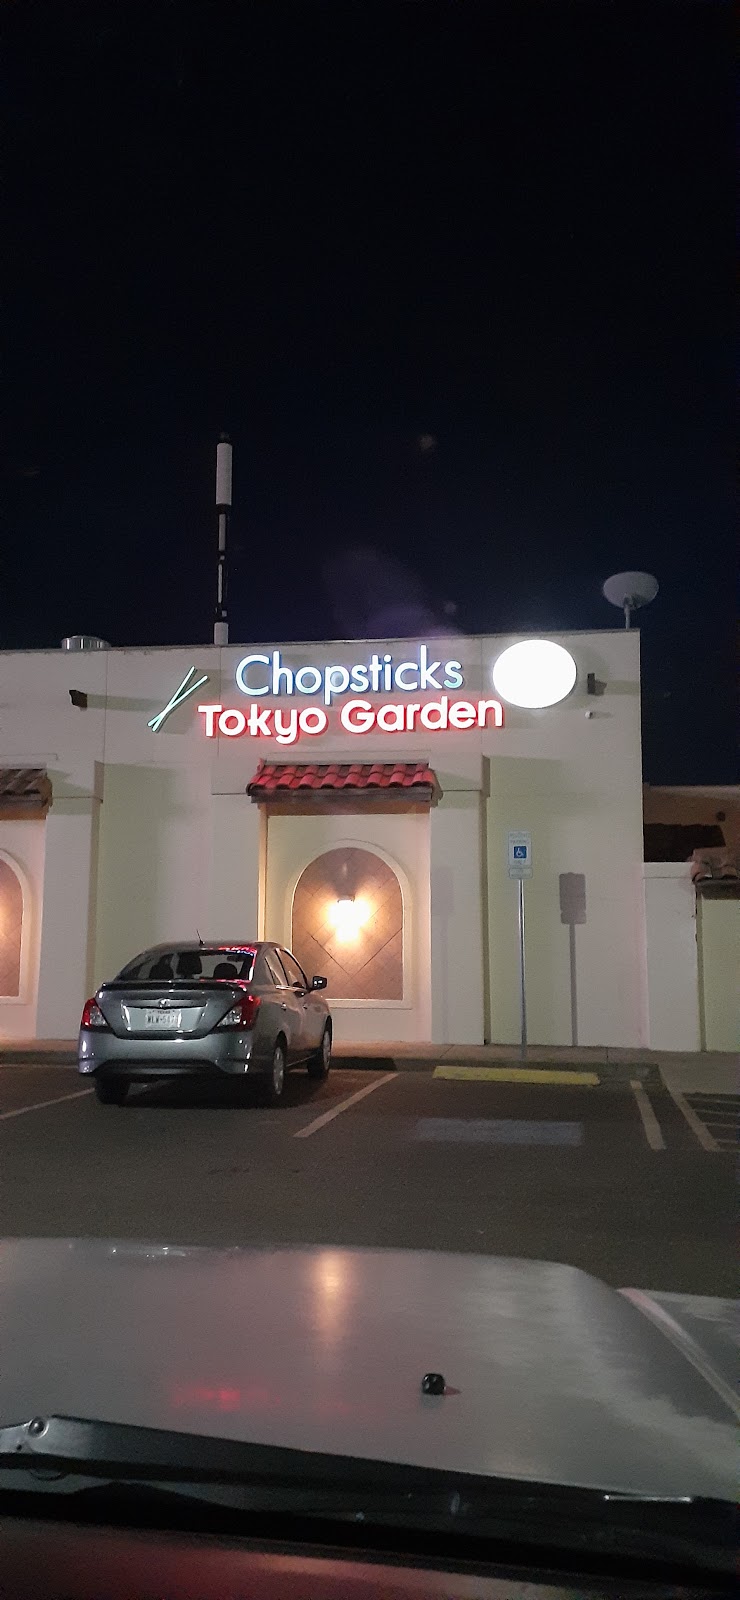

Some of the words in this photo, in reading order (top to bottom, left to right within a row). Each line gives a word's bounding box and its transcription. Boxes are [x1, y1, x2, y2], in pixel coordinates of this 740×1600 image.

[235, 645, 464, 705] Chopsticks
[198, 703, 328, 745] Tokyo
[341, 696, 504, 734] Garden
